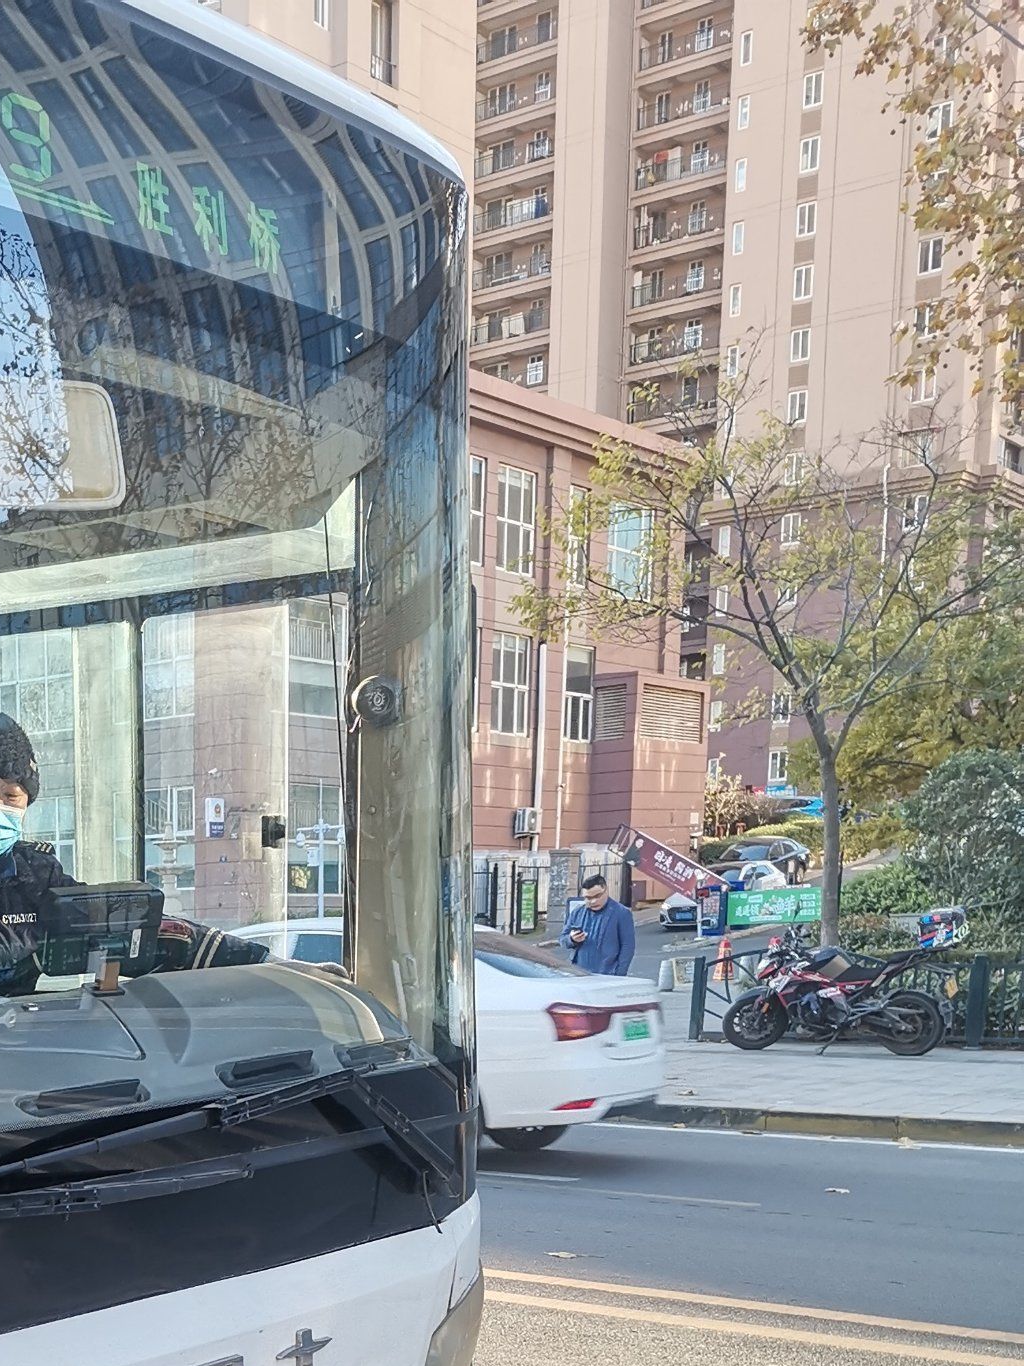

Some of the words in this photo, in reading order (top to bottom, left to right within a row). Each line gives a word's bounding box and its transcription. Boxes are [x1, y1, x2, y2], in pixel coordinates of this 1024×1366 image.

[1, 92, 52, 182] 9
[136, 160, 281, 274] 胜利桥
